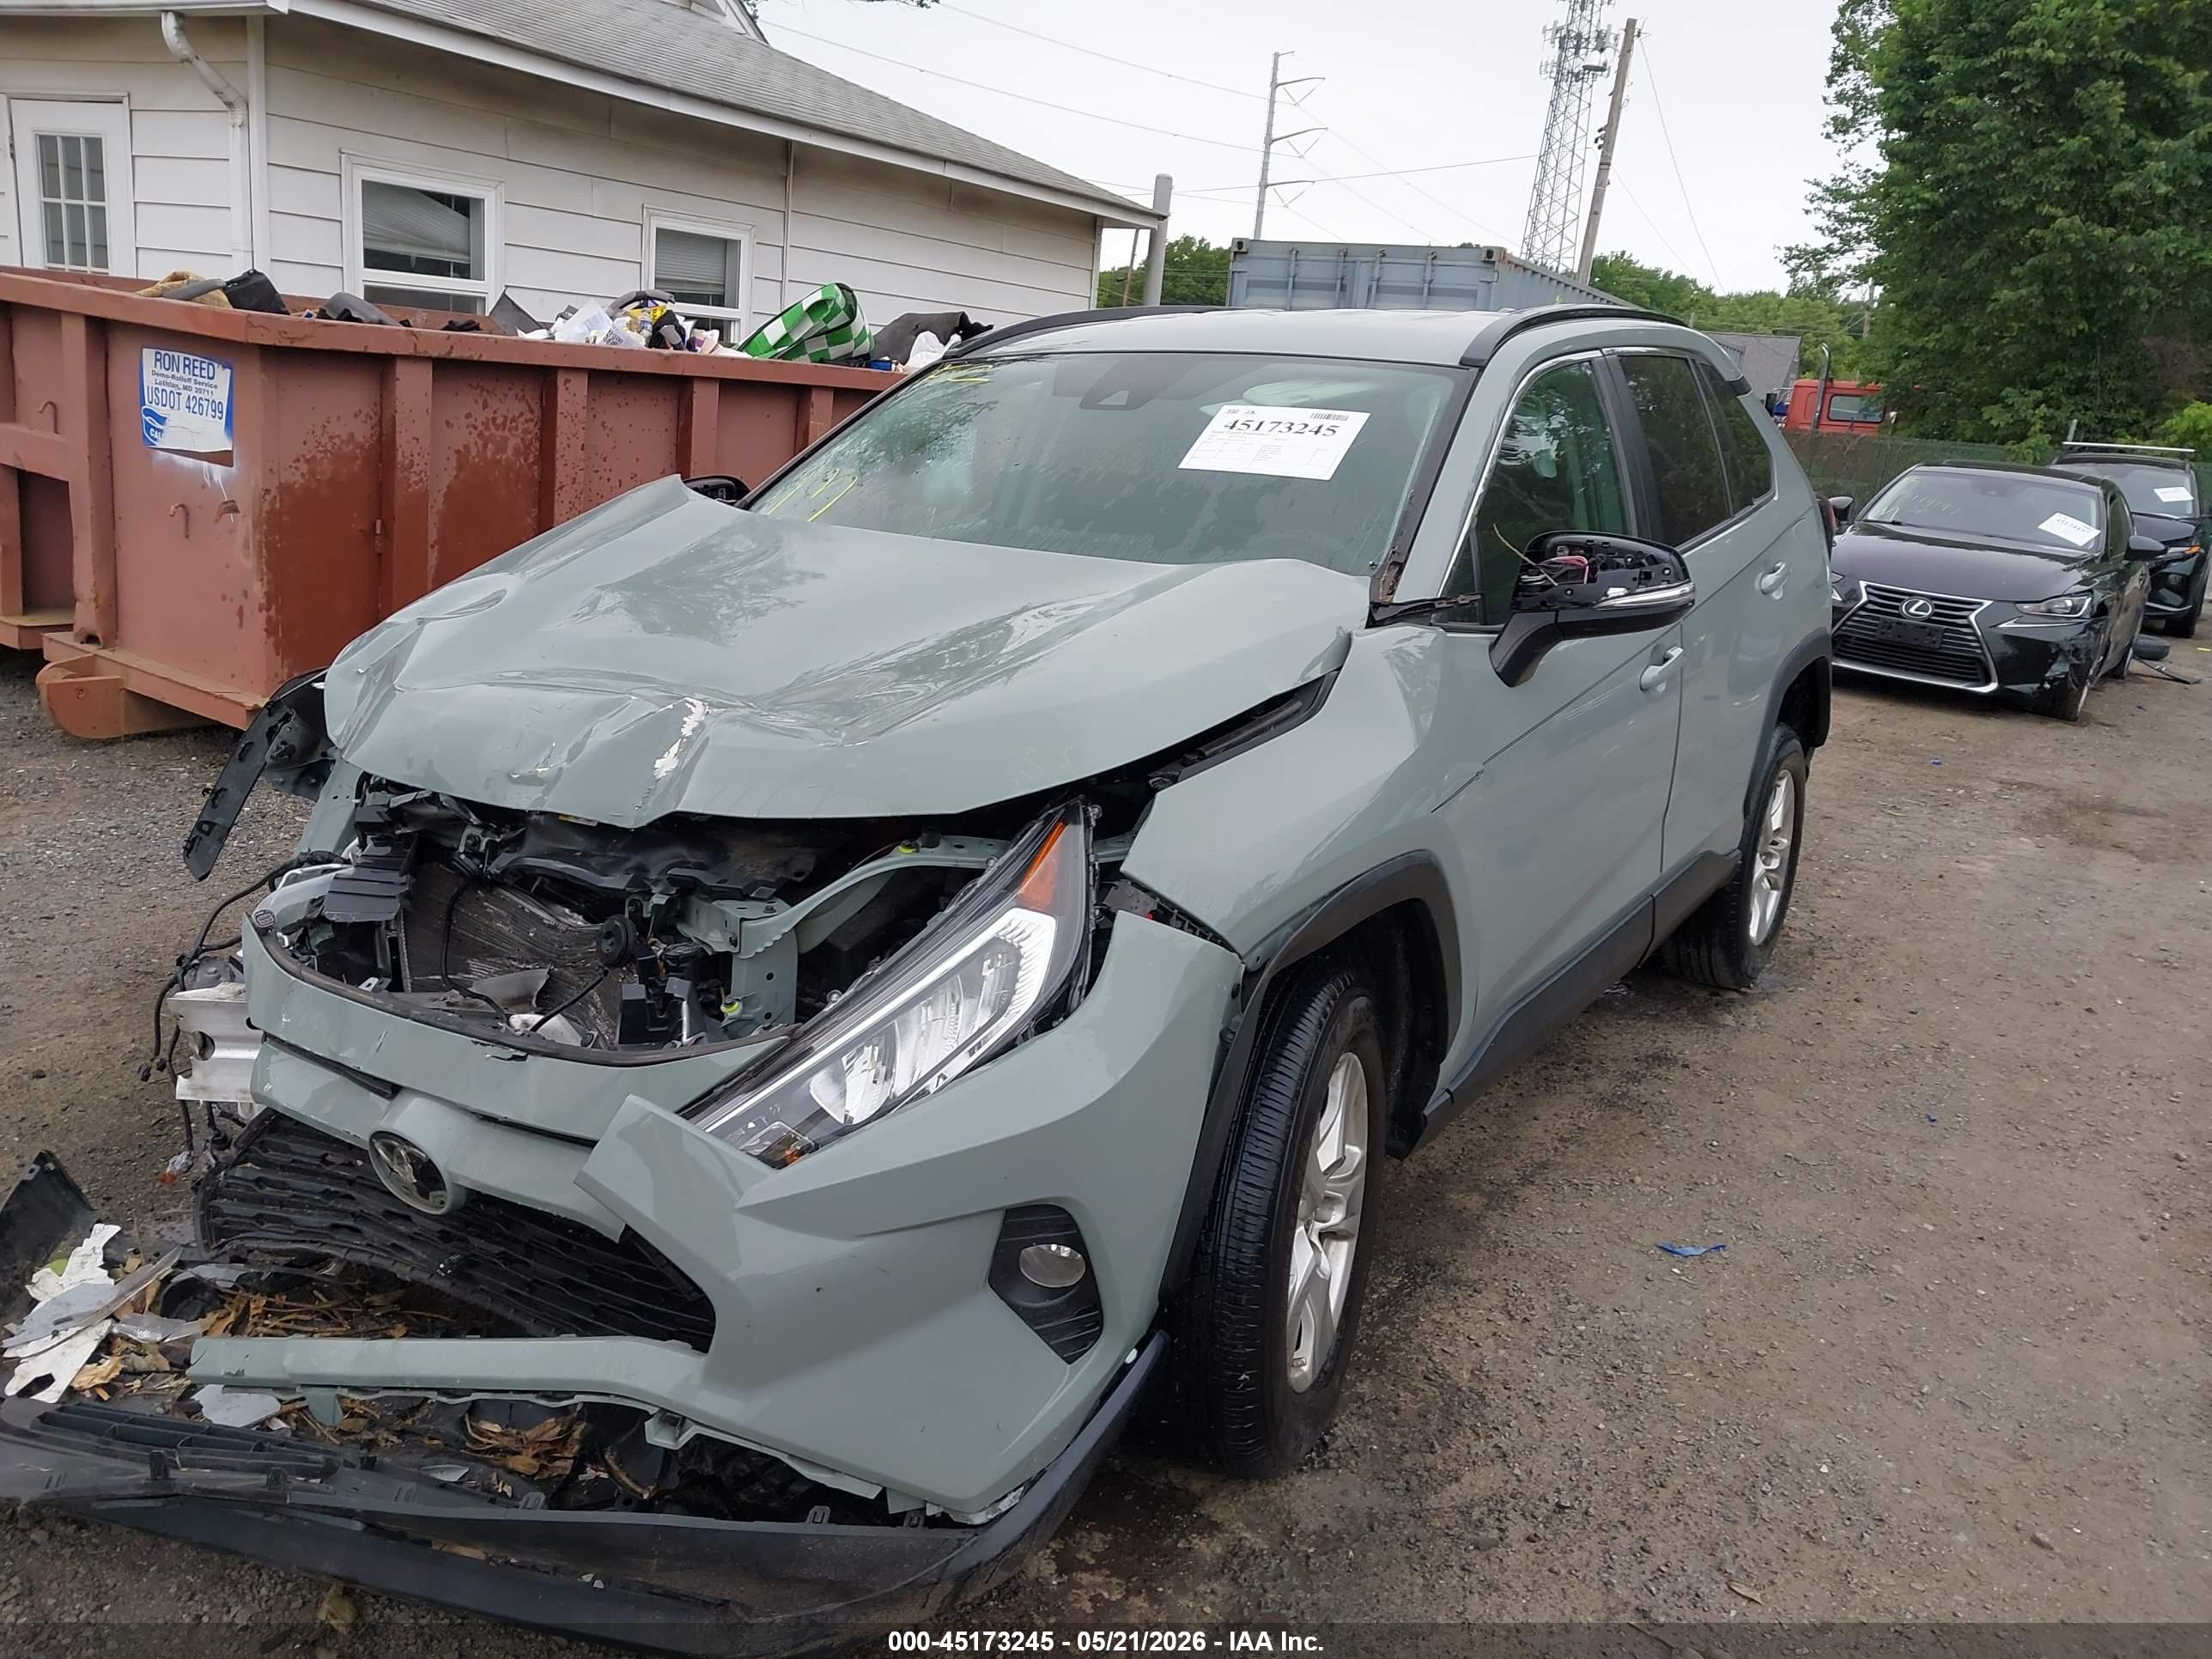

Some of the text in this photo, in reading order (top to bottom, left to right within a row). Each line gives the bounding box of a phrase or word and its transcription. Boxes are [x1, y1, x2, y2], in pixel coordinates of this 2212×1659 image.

[155, 351, 216, 380] RON REED
[193, 379, 218, 390] Service
[147, 386, 223, 420] USDOT 426799
[1224, 419, 1340, 436] 45173245
